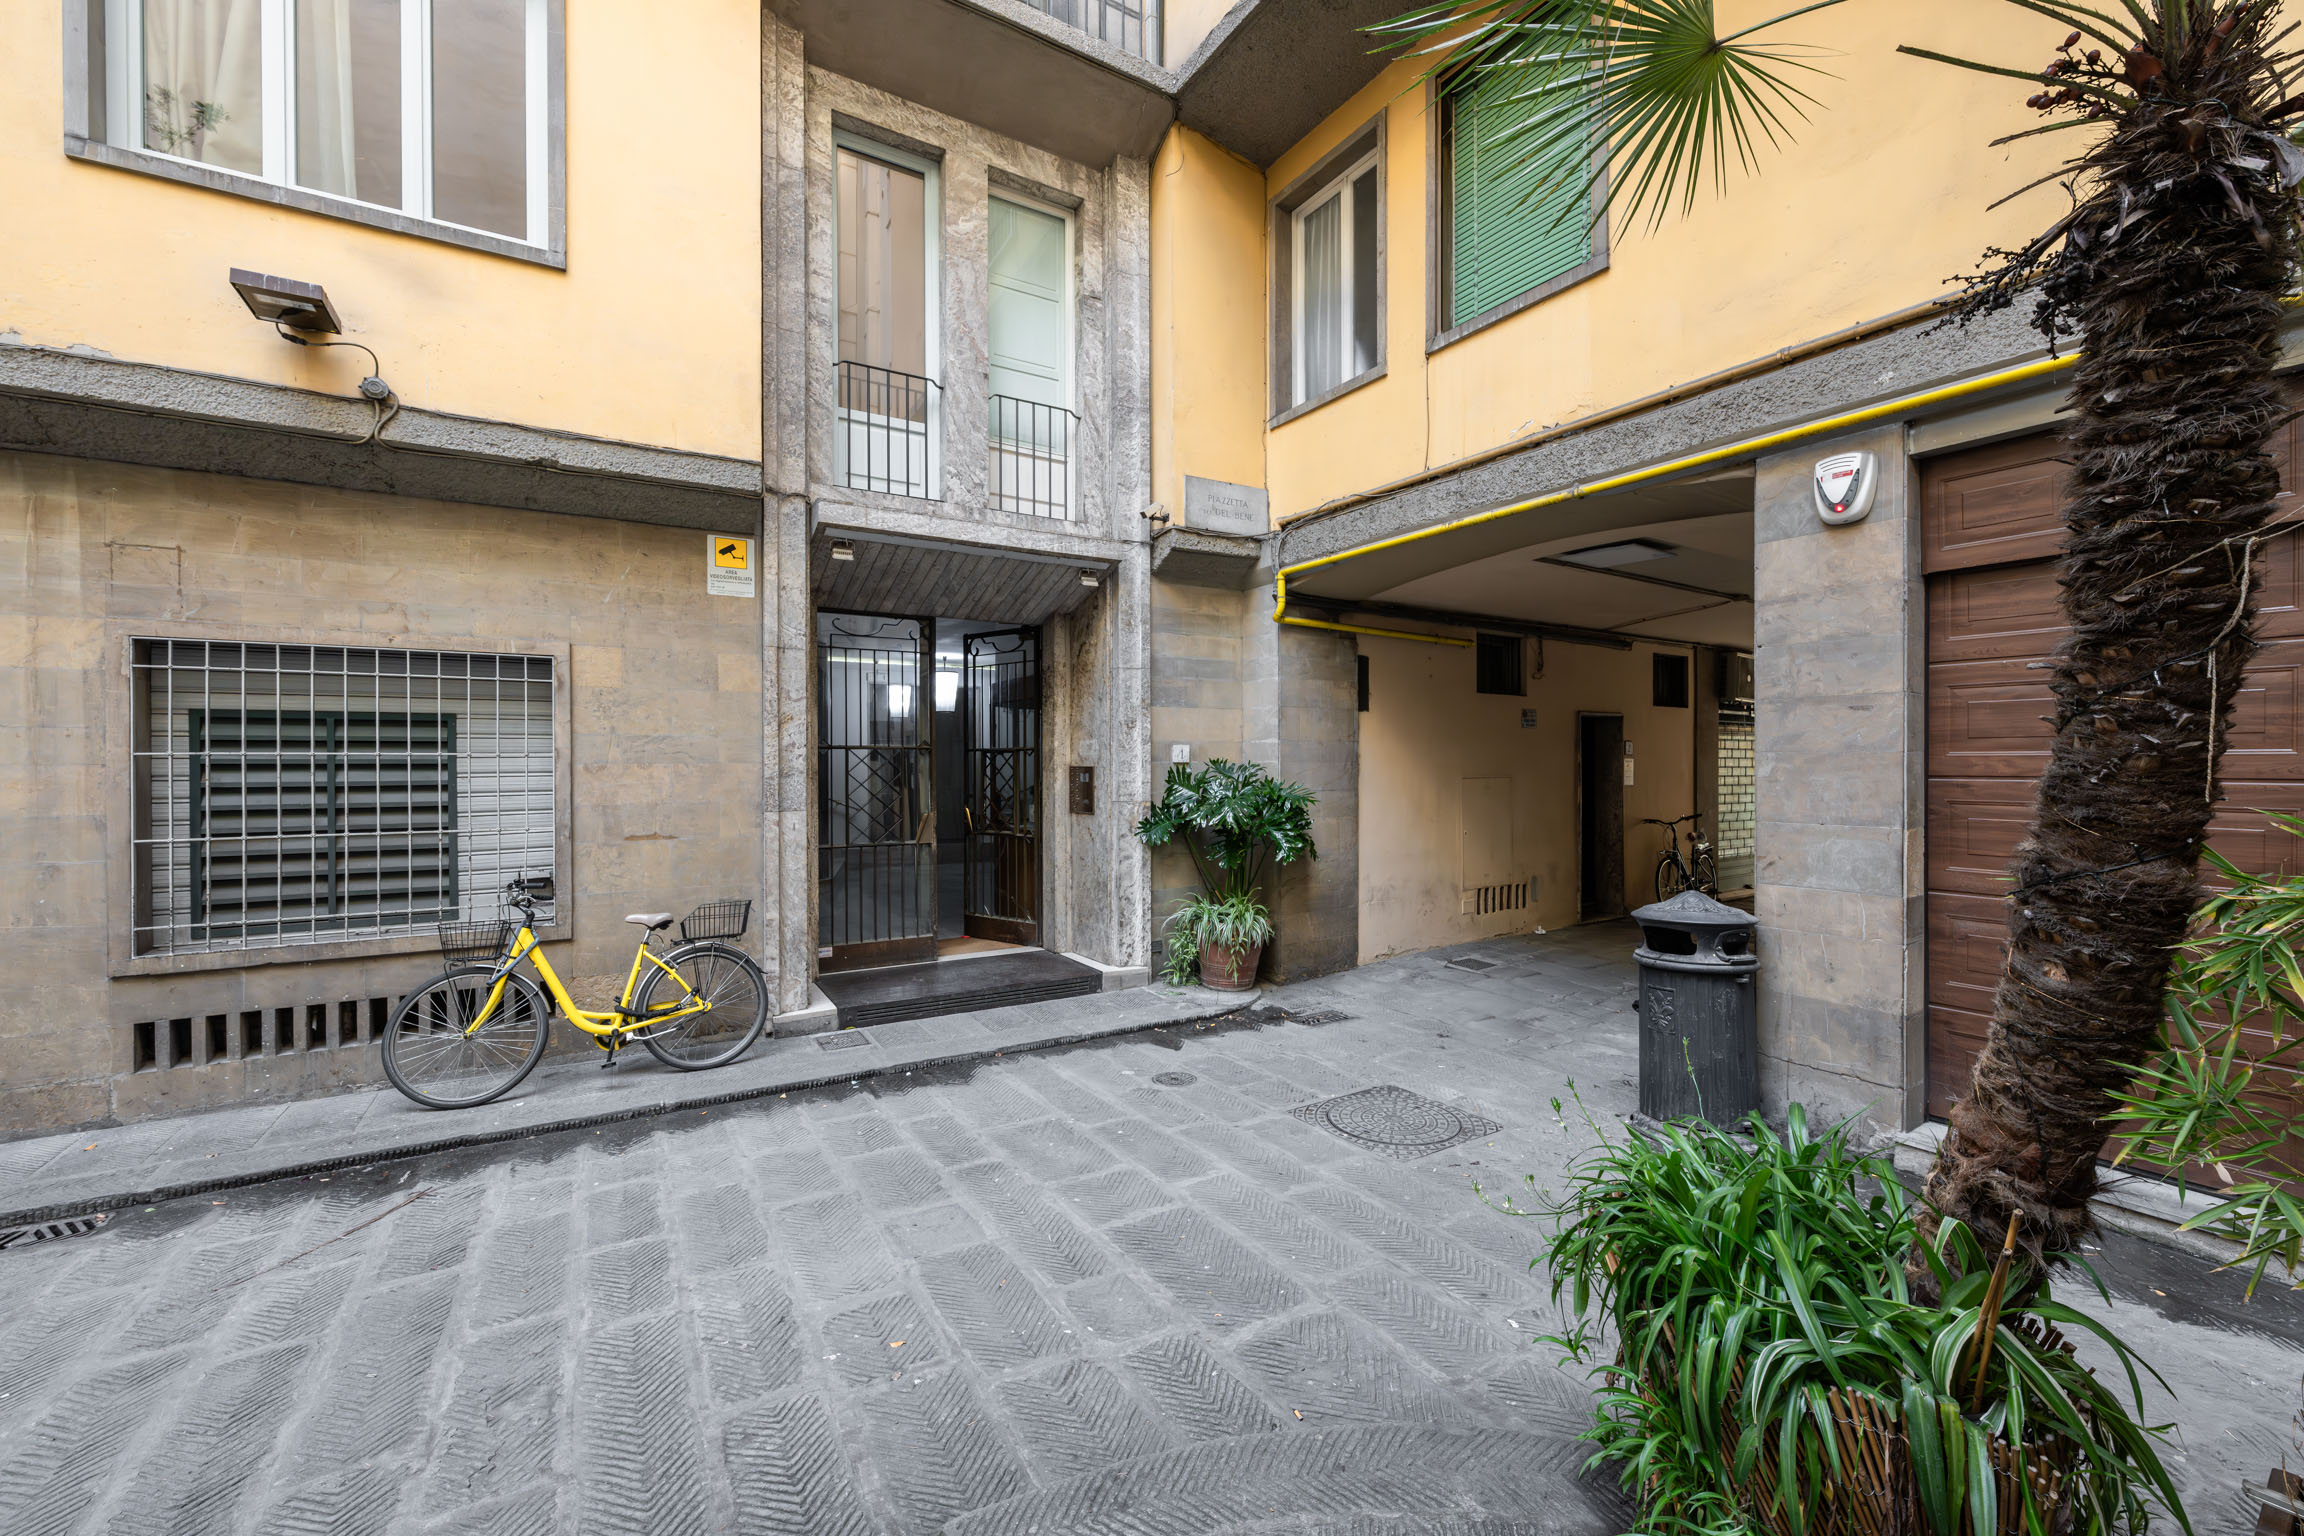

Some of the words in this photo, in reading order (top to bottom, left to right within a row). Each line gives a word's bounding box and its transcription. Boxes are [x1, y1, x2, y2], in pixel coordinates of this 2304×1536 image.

[1207, 494, 1249, 509] PIAZZETTA
[1215, 508, 1231, 518] DEL
[1234, 511, 1256, 521] BENE
